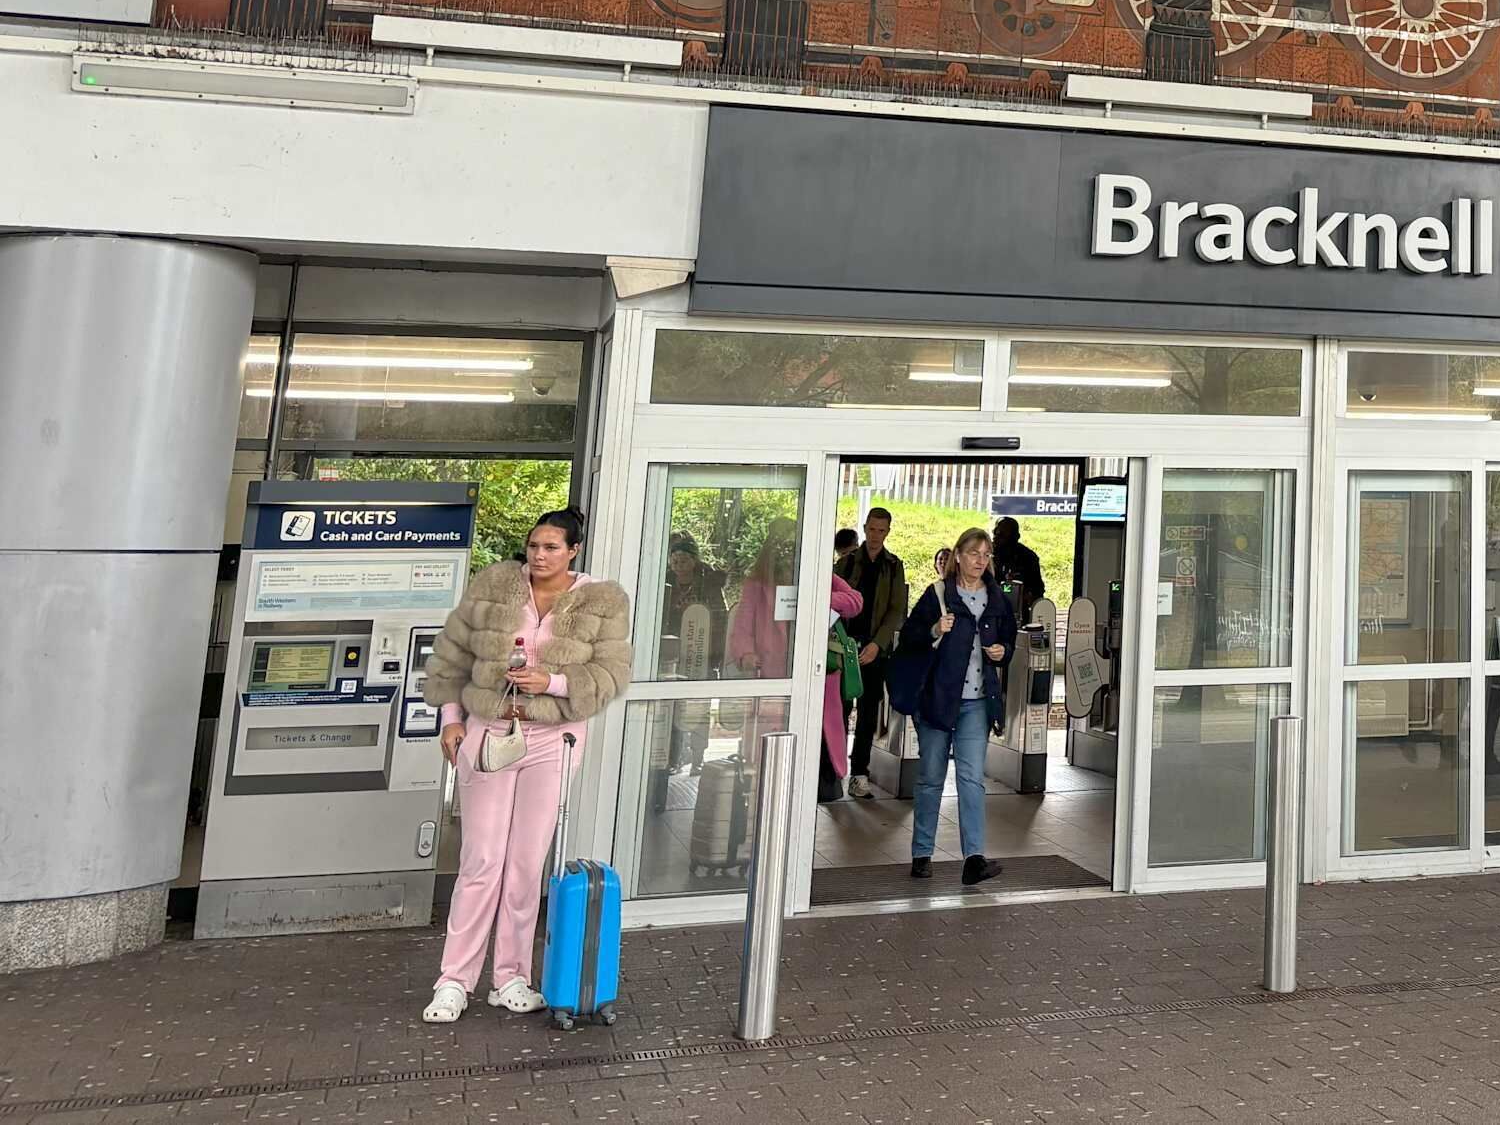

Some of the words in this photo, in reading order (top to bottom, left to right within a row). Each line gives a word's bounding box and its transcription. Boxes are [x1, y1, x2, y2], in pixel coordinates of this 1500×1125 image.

[1091, 173, 1493, 276] Bracknell
[1036, 499, 1078, 513] Brackn
[323, 510, 397, 525] TICKETS
[320, 531, 348, 541] Cash
[351, 530, 373, 541] and
[375, 530, 404, 541] Card
[405, 530, 461, 543] Payments
[274, 734, 306, 743] Tickets
[310, 734, 317, 742] &
[319, 733, 352, 742] Change
